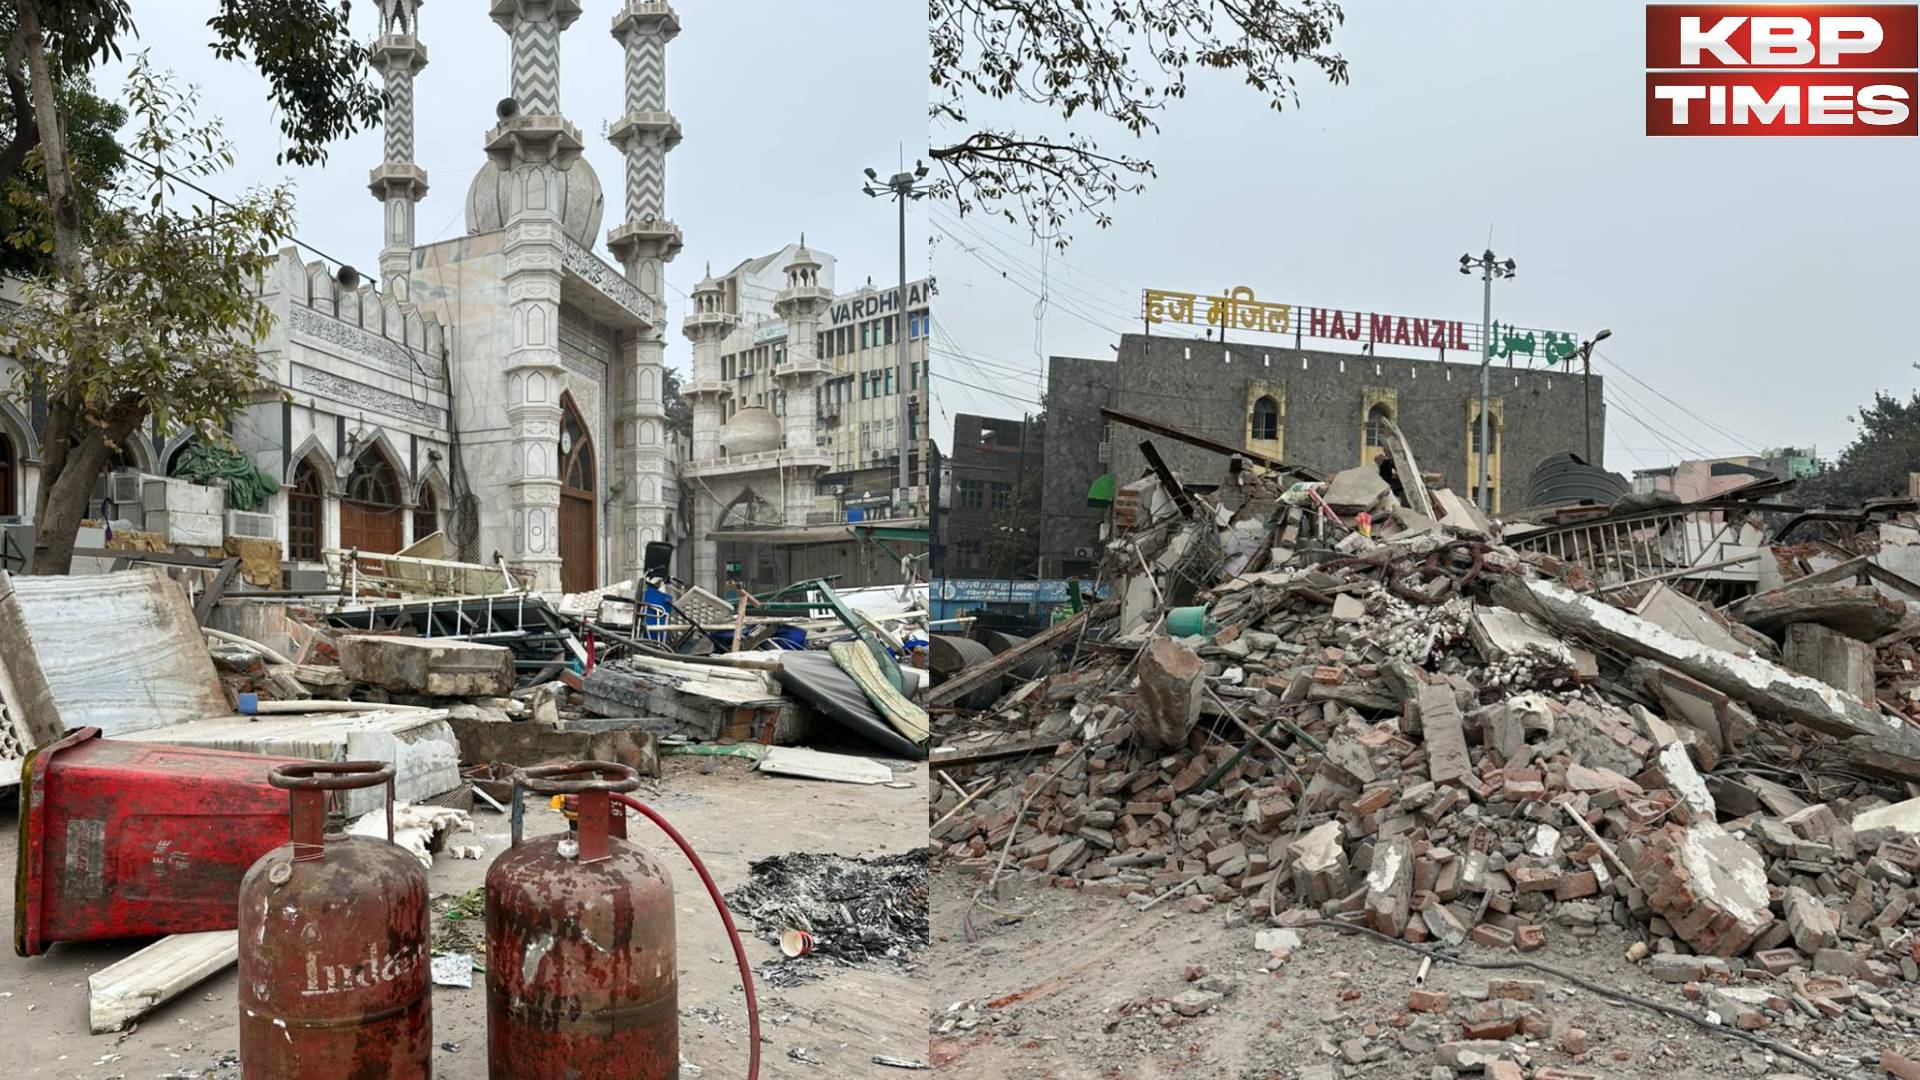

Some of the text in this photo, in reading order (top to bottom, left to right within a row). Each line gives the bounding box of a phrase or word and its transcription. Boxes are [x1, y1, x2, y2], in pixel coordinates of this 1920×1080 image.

[1146, 286, 1291, 334] हज मंजिल
[1310, 307, 1469, 351] HAJ MANZIL
